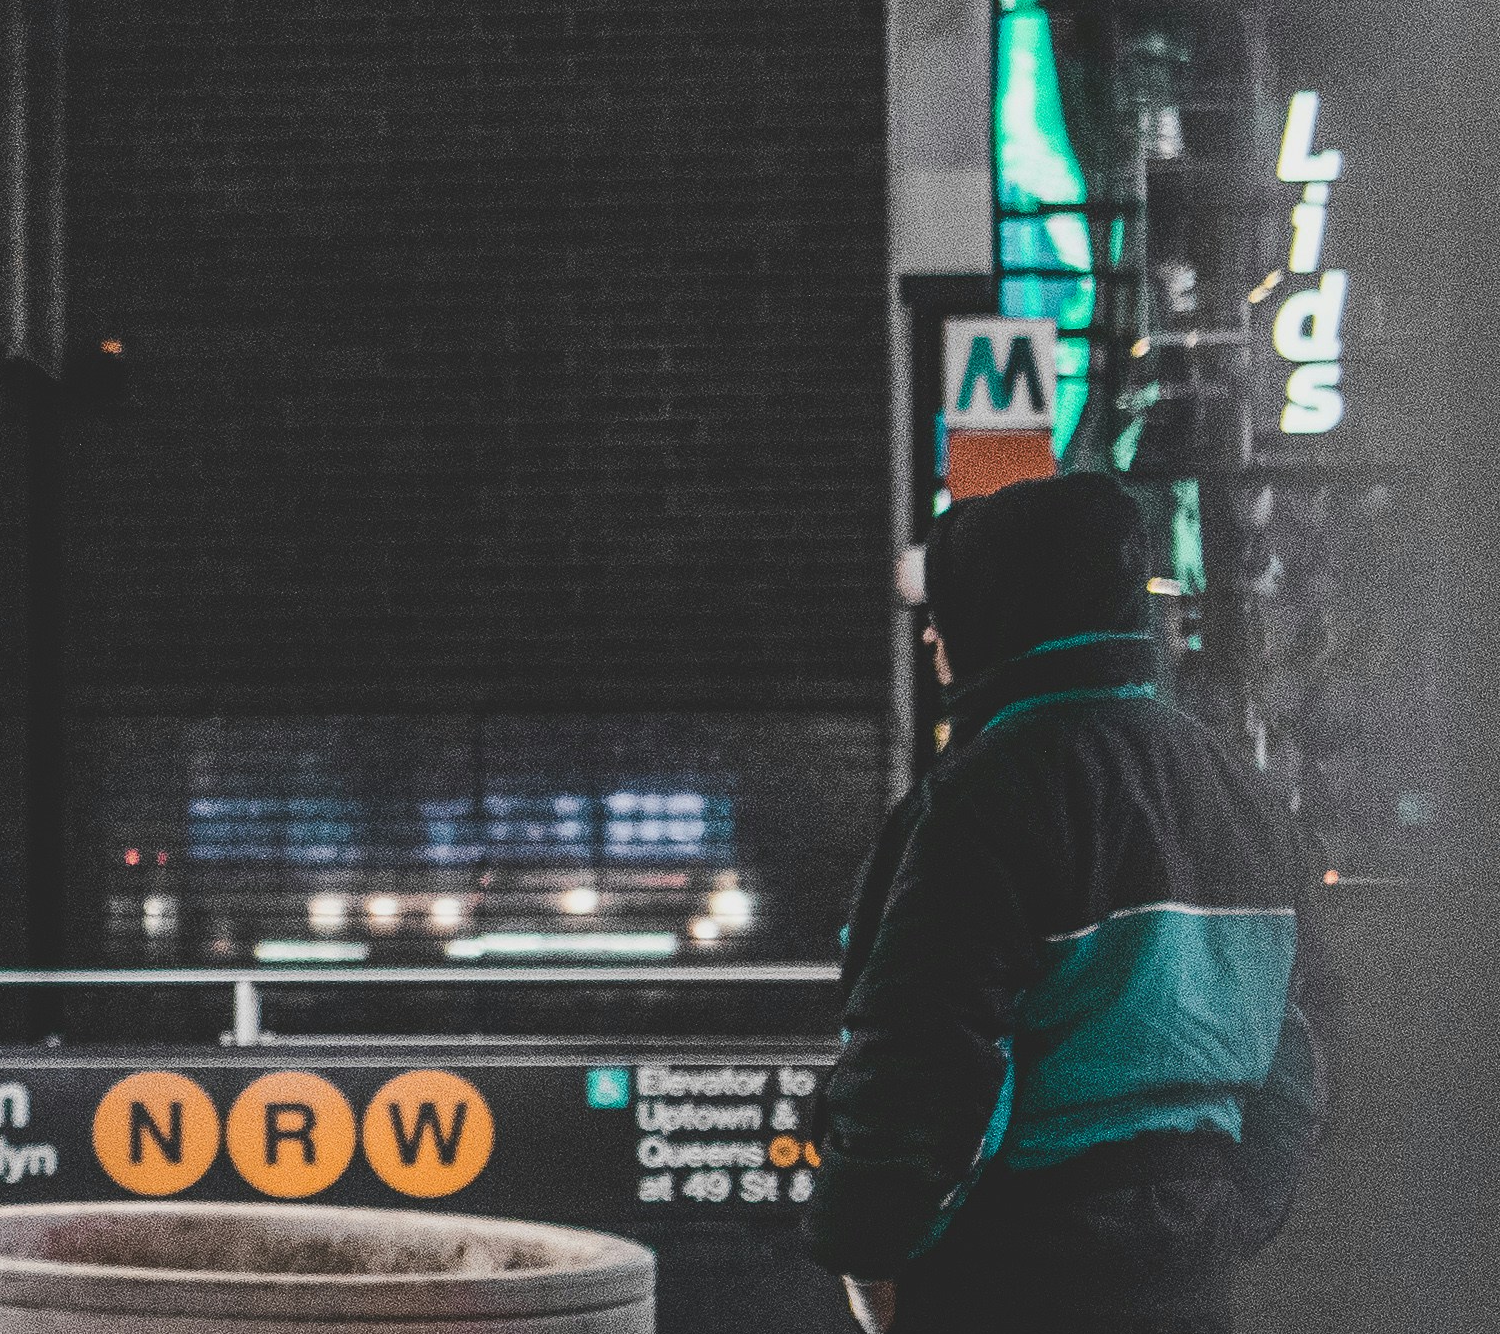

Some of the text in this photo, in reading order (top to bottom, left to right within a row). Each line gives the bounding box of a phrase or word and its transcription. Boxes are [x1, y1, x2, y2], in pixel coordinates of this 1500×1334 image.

[1276, 90, 1345, 434] Lids
[636, 1067, 816, 1097] Elevator to
[126, 1100, 468, 1165] N R W
[636, 1100, 800, 1135] Uptown &
[636, 1135, 766, 1169] Queens
[637, 1171, 675, 1202] at
[681, 1169, 732, 1203] 49
[739, 1169, 779, 1203] St
